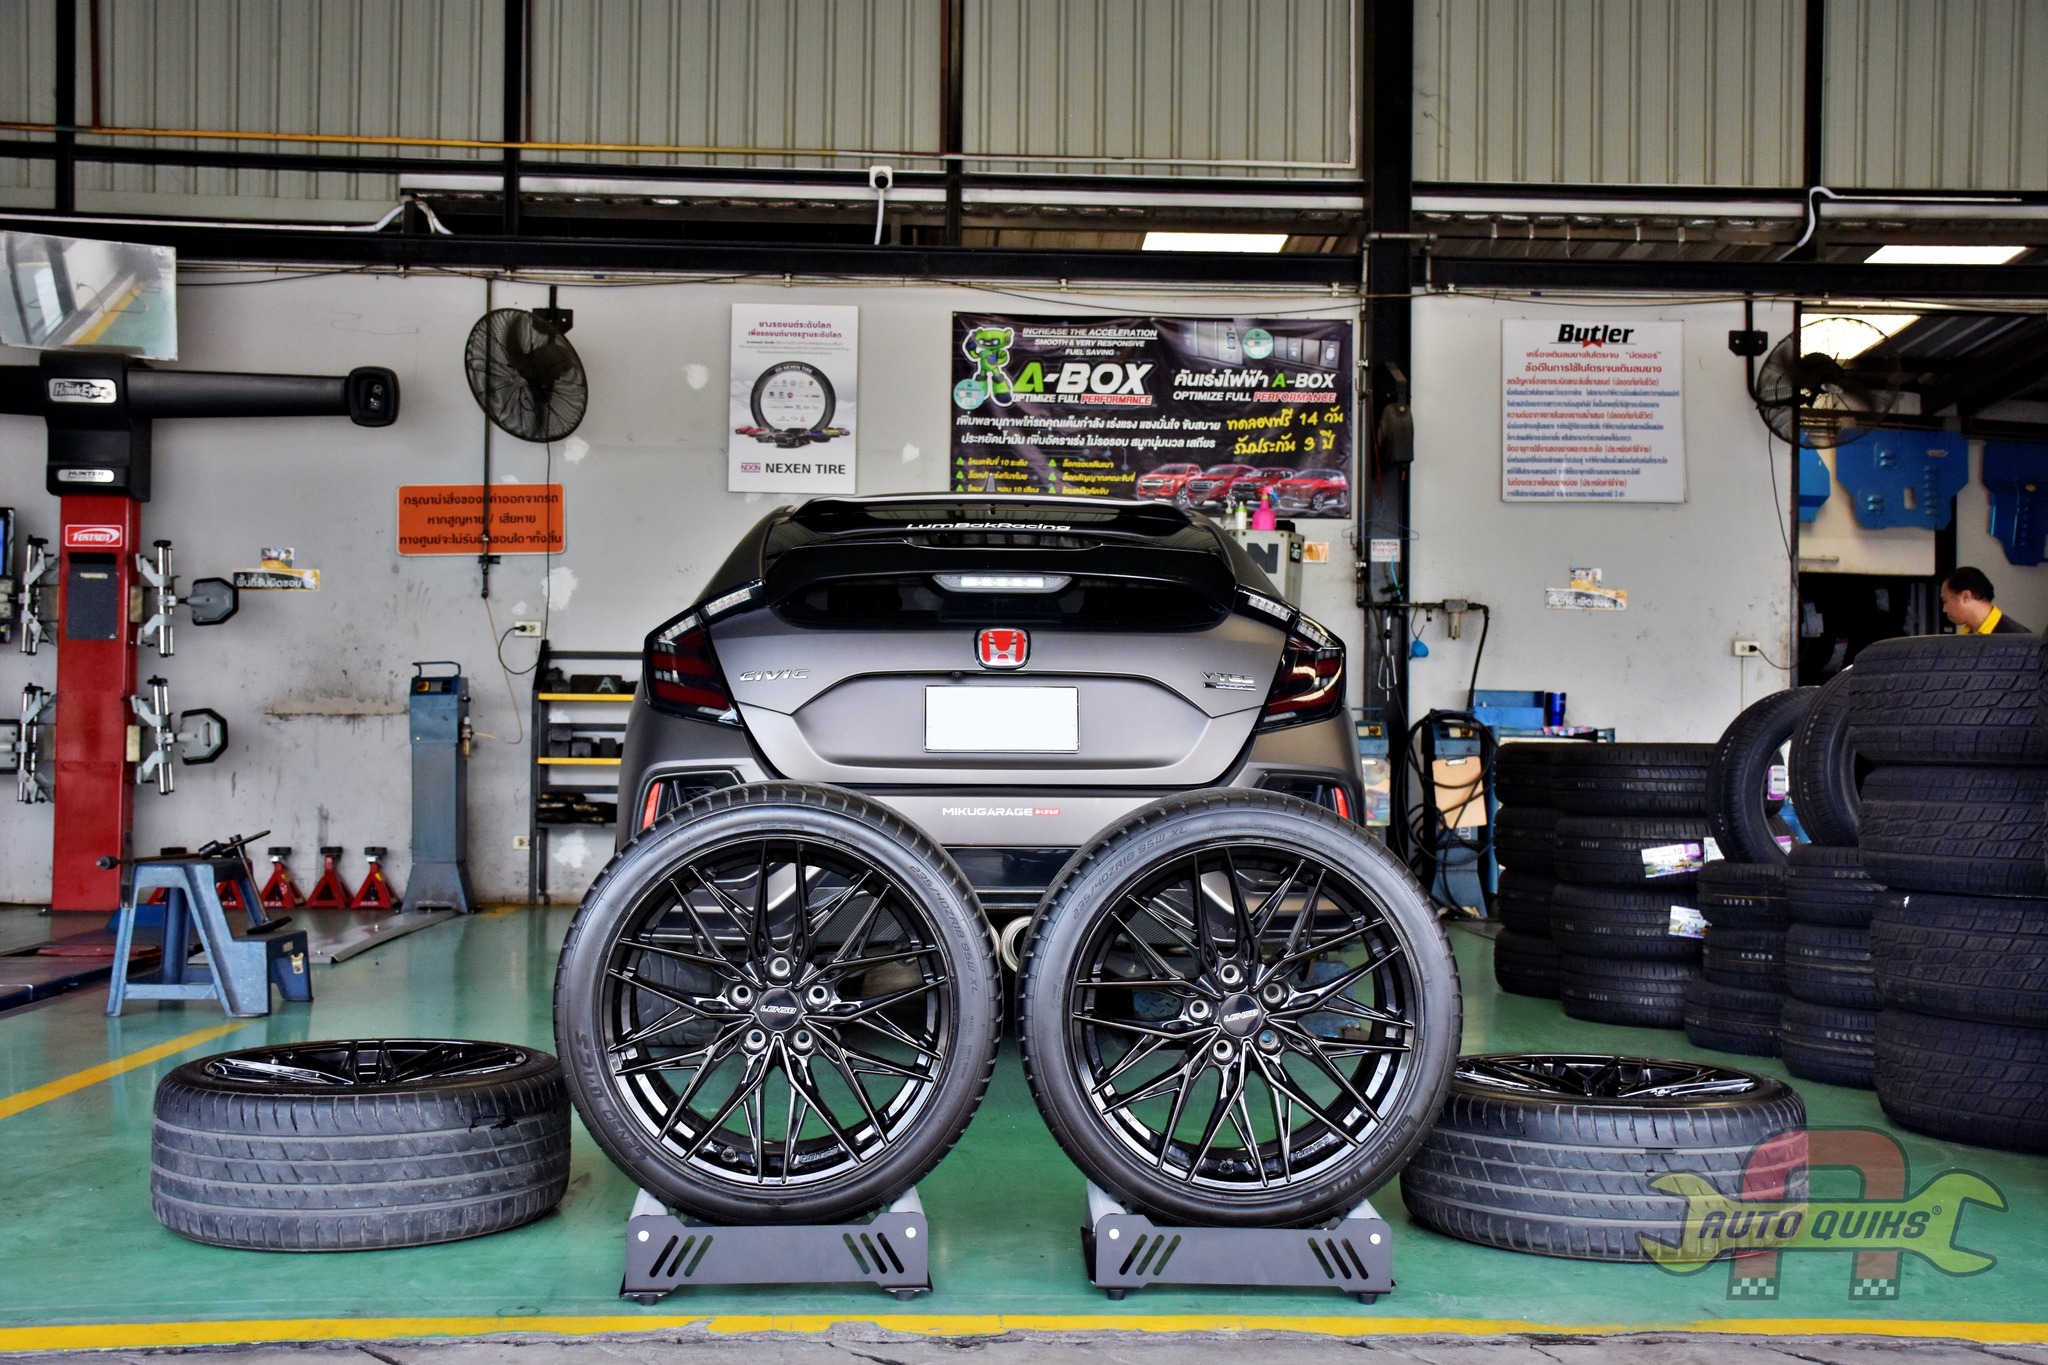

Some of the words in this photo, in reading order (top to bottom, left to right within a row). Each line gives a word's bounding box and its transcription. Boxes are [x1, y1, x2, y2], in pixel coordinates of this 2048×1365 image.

[1023, 328, 1068, 336] INCREASE
[1088, 329, 1157, 337] ACCELERATION
[1558, 324, 1634, 344] Butler
[1098, 340, 1145, 348] RESPONSIVE
[1013, 362, 1154, 394] A-BOX
[1174, 368, 1268, 388] คันเร่งไฟฟ้า
[1272, 372, 1336, 388] A-BOX
[1012, 394, 1056, 403] OPTIMIZE
[1058, 394, 1079, 404] FULL
[1080, 394, 1152, 405] PERFORMANCE
[1173, 391, 1224, 401] OPTIMIZE
[1226, 392, 1251, 401] FULL
[1253, 392, 1336, 402] PERFORMANCE
[1226, 408, 1294, 430] ทดลองฟรี
[1299, 412, 1318, 426] 14
[1324, 406, 1344, 424] วัน
[1304, 436, 1315, 450] 3
[1320, 429, 1335, 450] ปี
[766, 463, 811, 474] NEXEN
[815, 464, 846, 474] TIRE
[499, 512, 536, 524] เสียหาย
[740, 668, 810, 682] CIVIC
[942, 808, 1033, 816] MIKUGARAGE
[760, 1004, 797, 1014] LENSO
[1224, 1009, 1258, 1022] LENSO
